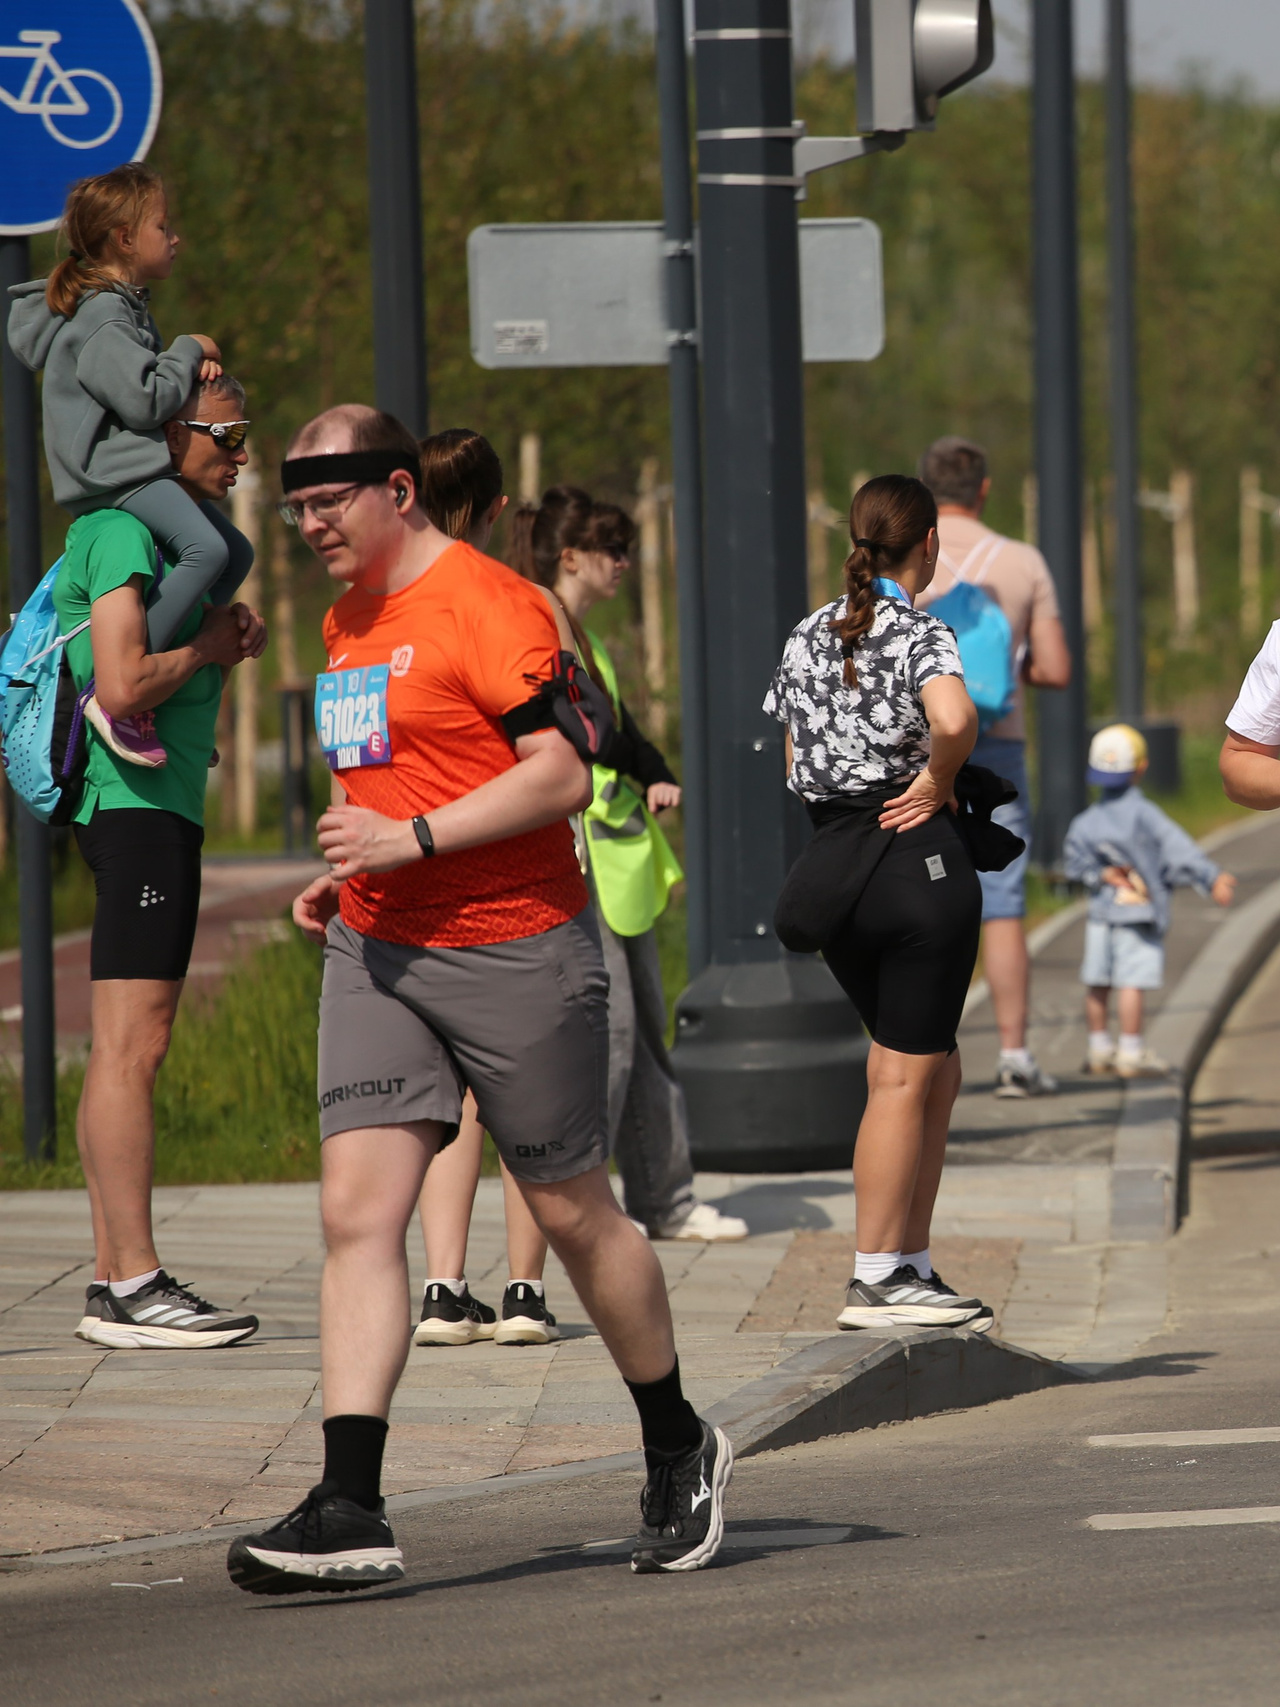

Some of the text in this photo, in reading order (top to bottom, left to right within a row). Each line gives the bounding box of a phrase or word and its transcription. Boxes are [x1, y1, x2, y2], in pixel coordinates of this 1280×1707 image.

[320, 692, 380, 748] 51023
[370, 734, 381, 752] E
[336, 745, 361, 769] 10KM
